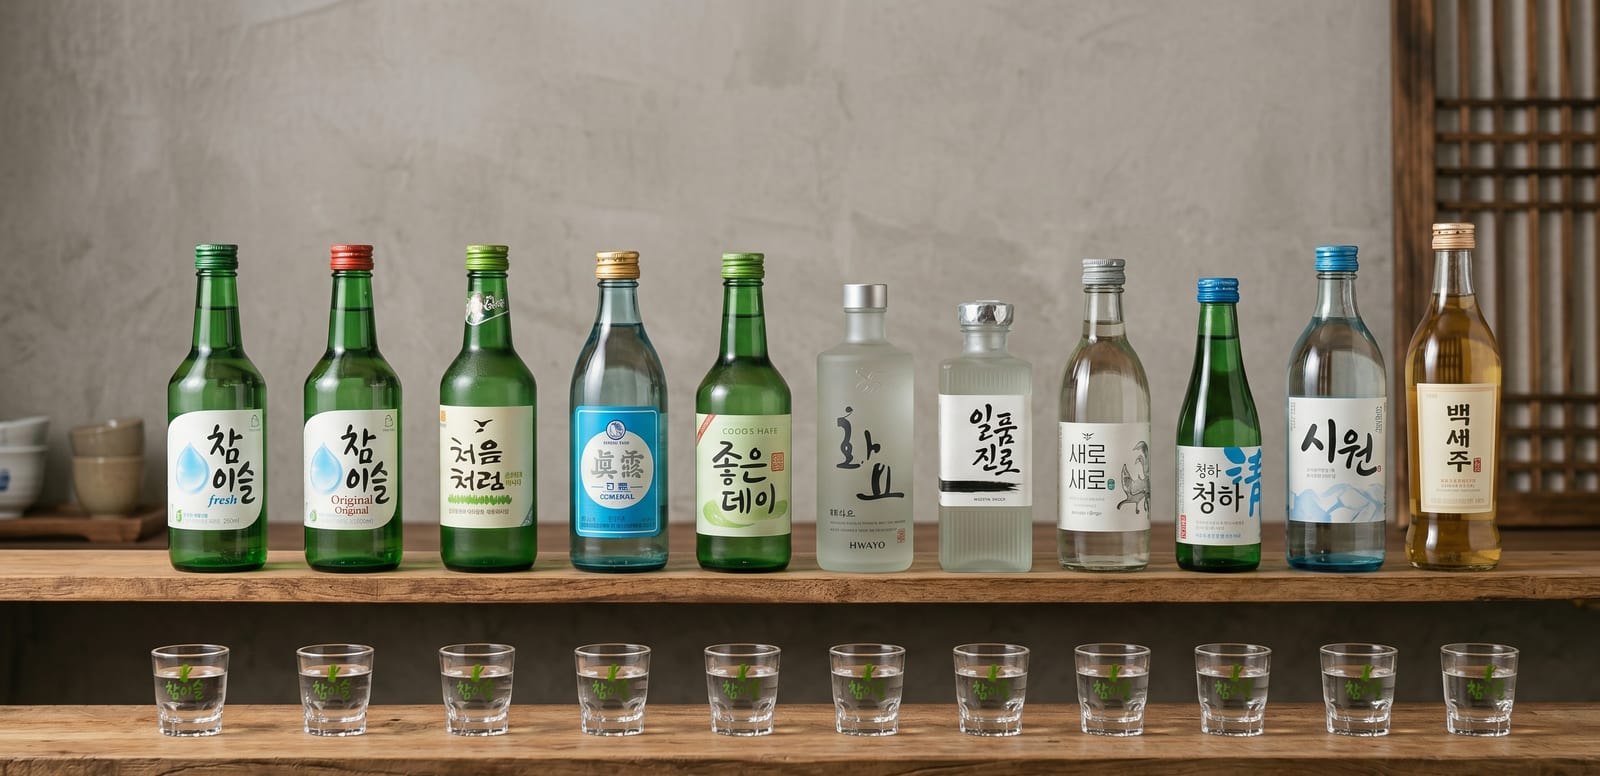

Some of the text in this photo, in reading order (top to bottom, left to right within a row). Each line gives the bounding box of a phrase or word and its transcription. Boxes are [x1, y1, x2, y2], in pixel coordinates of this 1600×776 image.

[969, 403, 1018, 447] 일품
[207, 424, 243, 464] 참
[341, 424, 376, 464] 참
[450, 437, 503, 465] 처음
[972, 443, 1021, 476] 진로
[1069, 444, 1107, 464] 새로
[1301, 418, 1378, 477] 시원
[712, 441, 767, 486] 좋은
[1195, 463, 1222, 479] 청하
[212, 461, 256, 504] 이슬
[346, 461, 390, 504] 이슬
[450, 468, 505, 491] 처럼
[1069, 469, 1107, 490] 새로
[208, 494, 238, 508] fresh
[331, 494, 373, 507] Original
[722, 483, 776, 514] 데이
[1192, 481, 1245, 514] 청하
[849, 541, 886, 549] HWAYO
[166, 680, 204, 701] 참이슬
